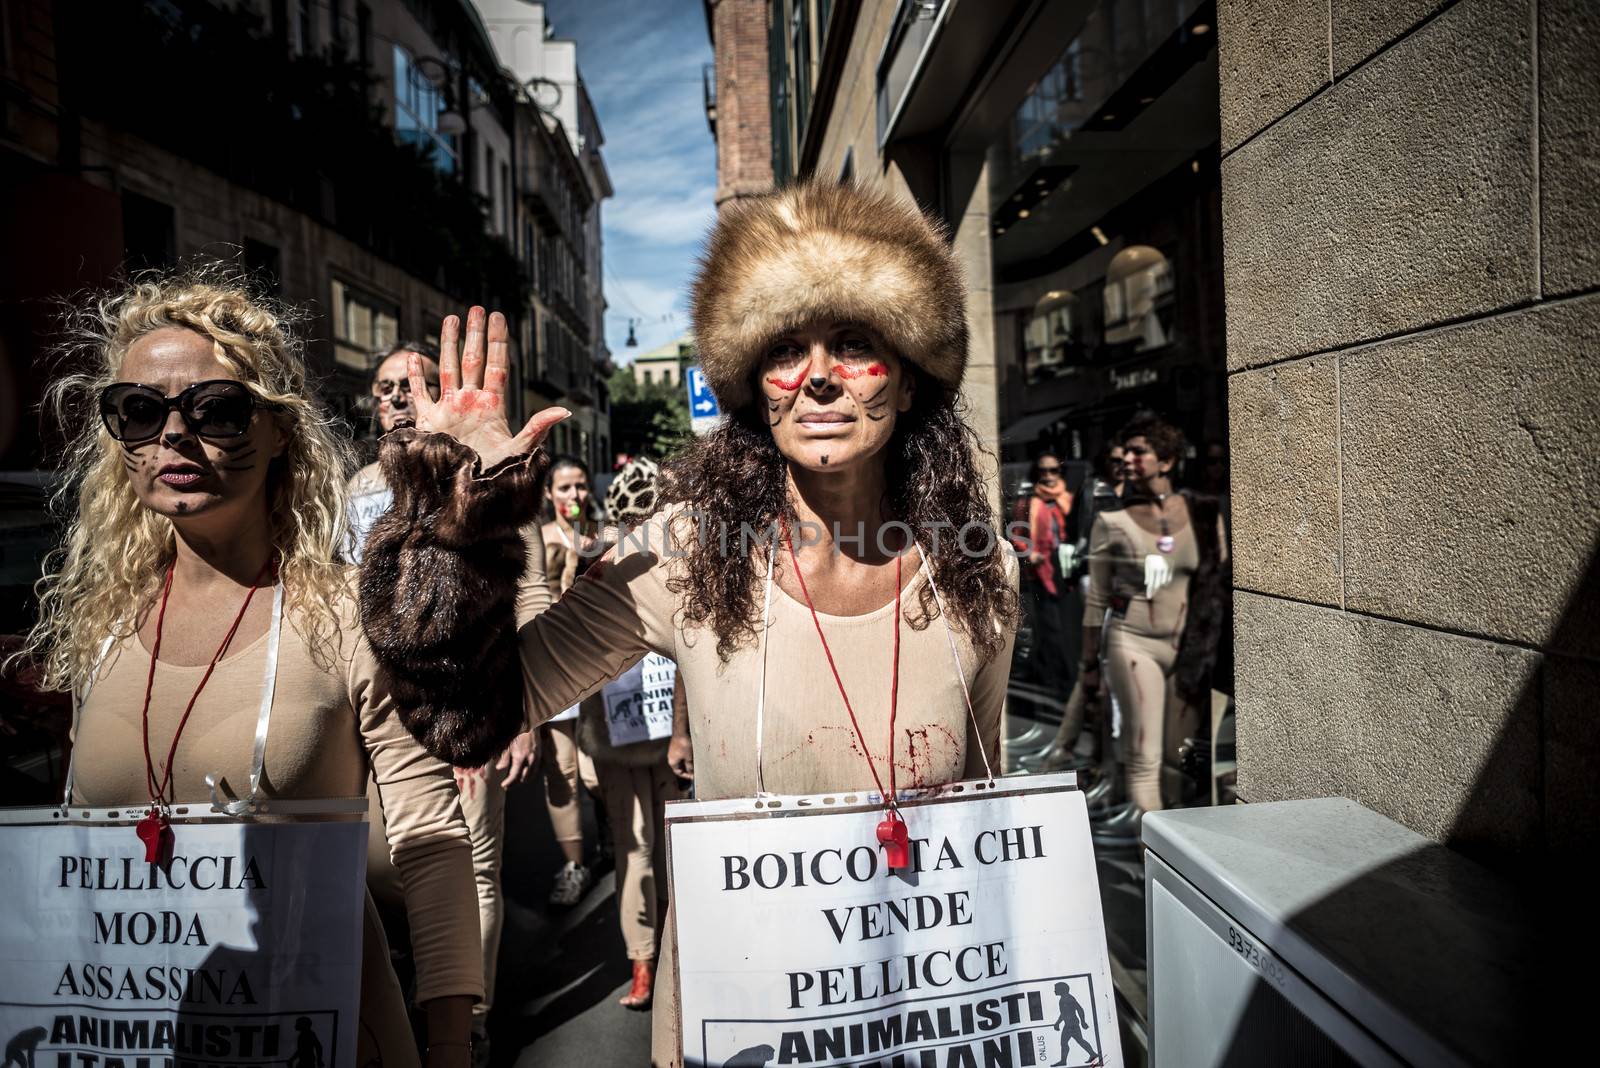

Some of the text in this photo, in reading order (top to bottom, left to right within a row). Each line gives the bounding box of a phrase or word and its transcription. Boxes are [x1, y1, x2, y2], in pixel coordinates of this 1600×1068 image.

[57, 855, 268, 890] PELLICCIA
[721, 825, 1047, 891] BOICOTA CHI
[93, 911, 210, 946] MODA
[821, 890, 973, 944] VENDE
[54, 962, 258, 1005] ASSASSINA
[787, 941, 1008, 1009] PELLICCE
[49, 1014, 281, 1057] ANIMALISTI
[777, 991, 1044, 1065] ANIMALISTI
[1039, 1035, 1047, 1061] ONLUS
